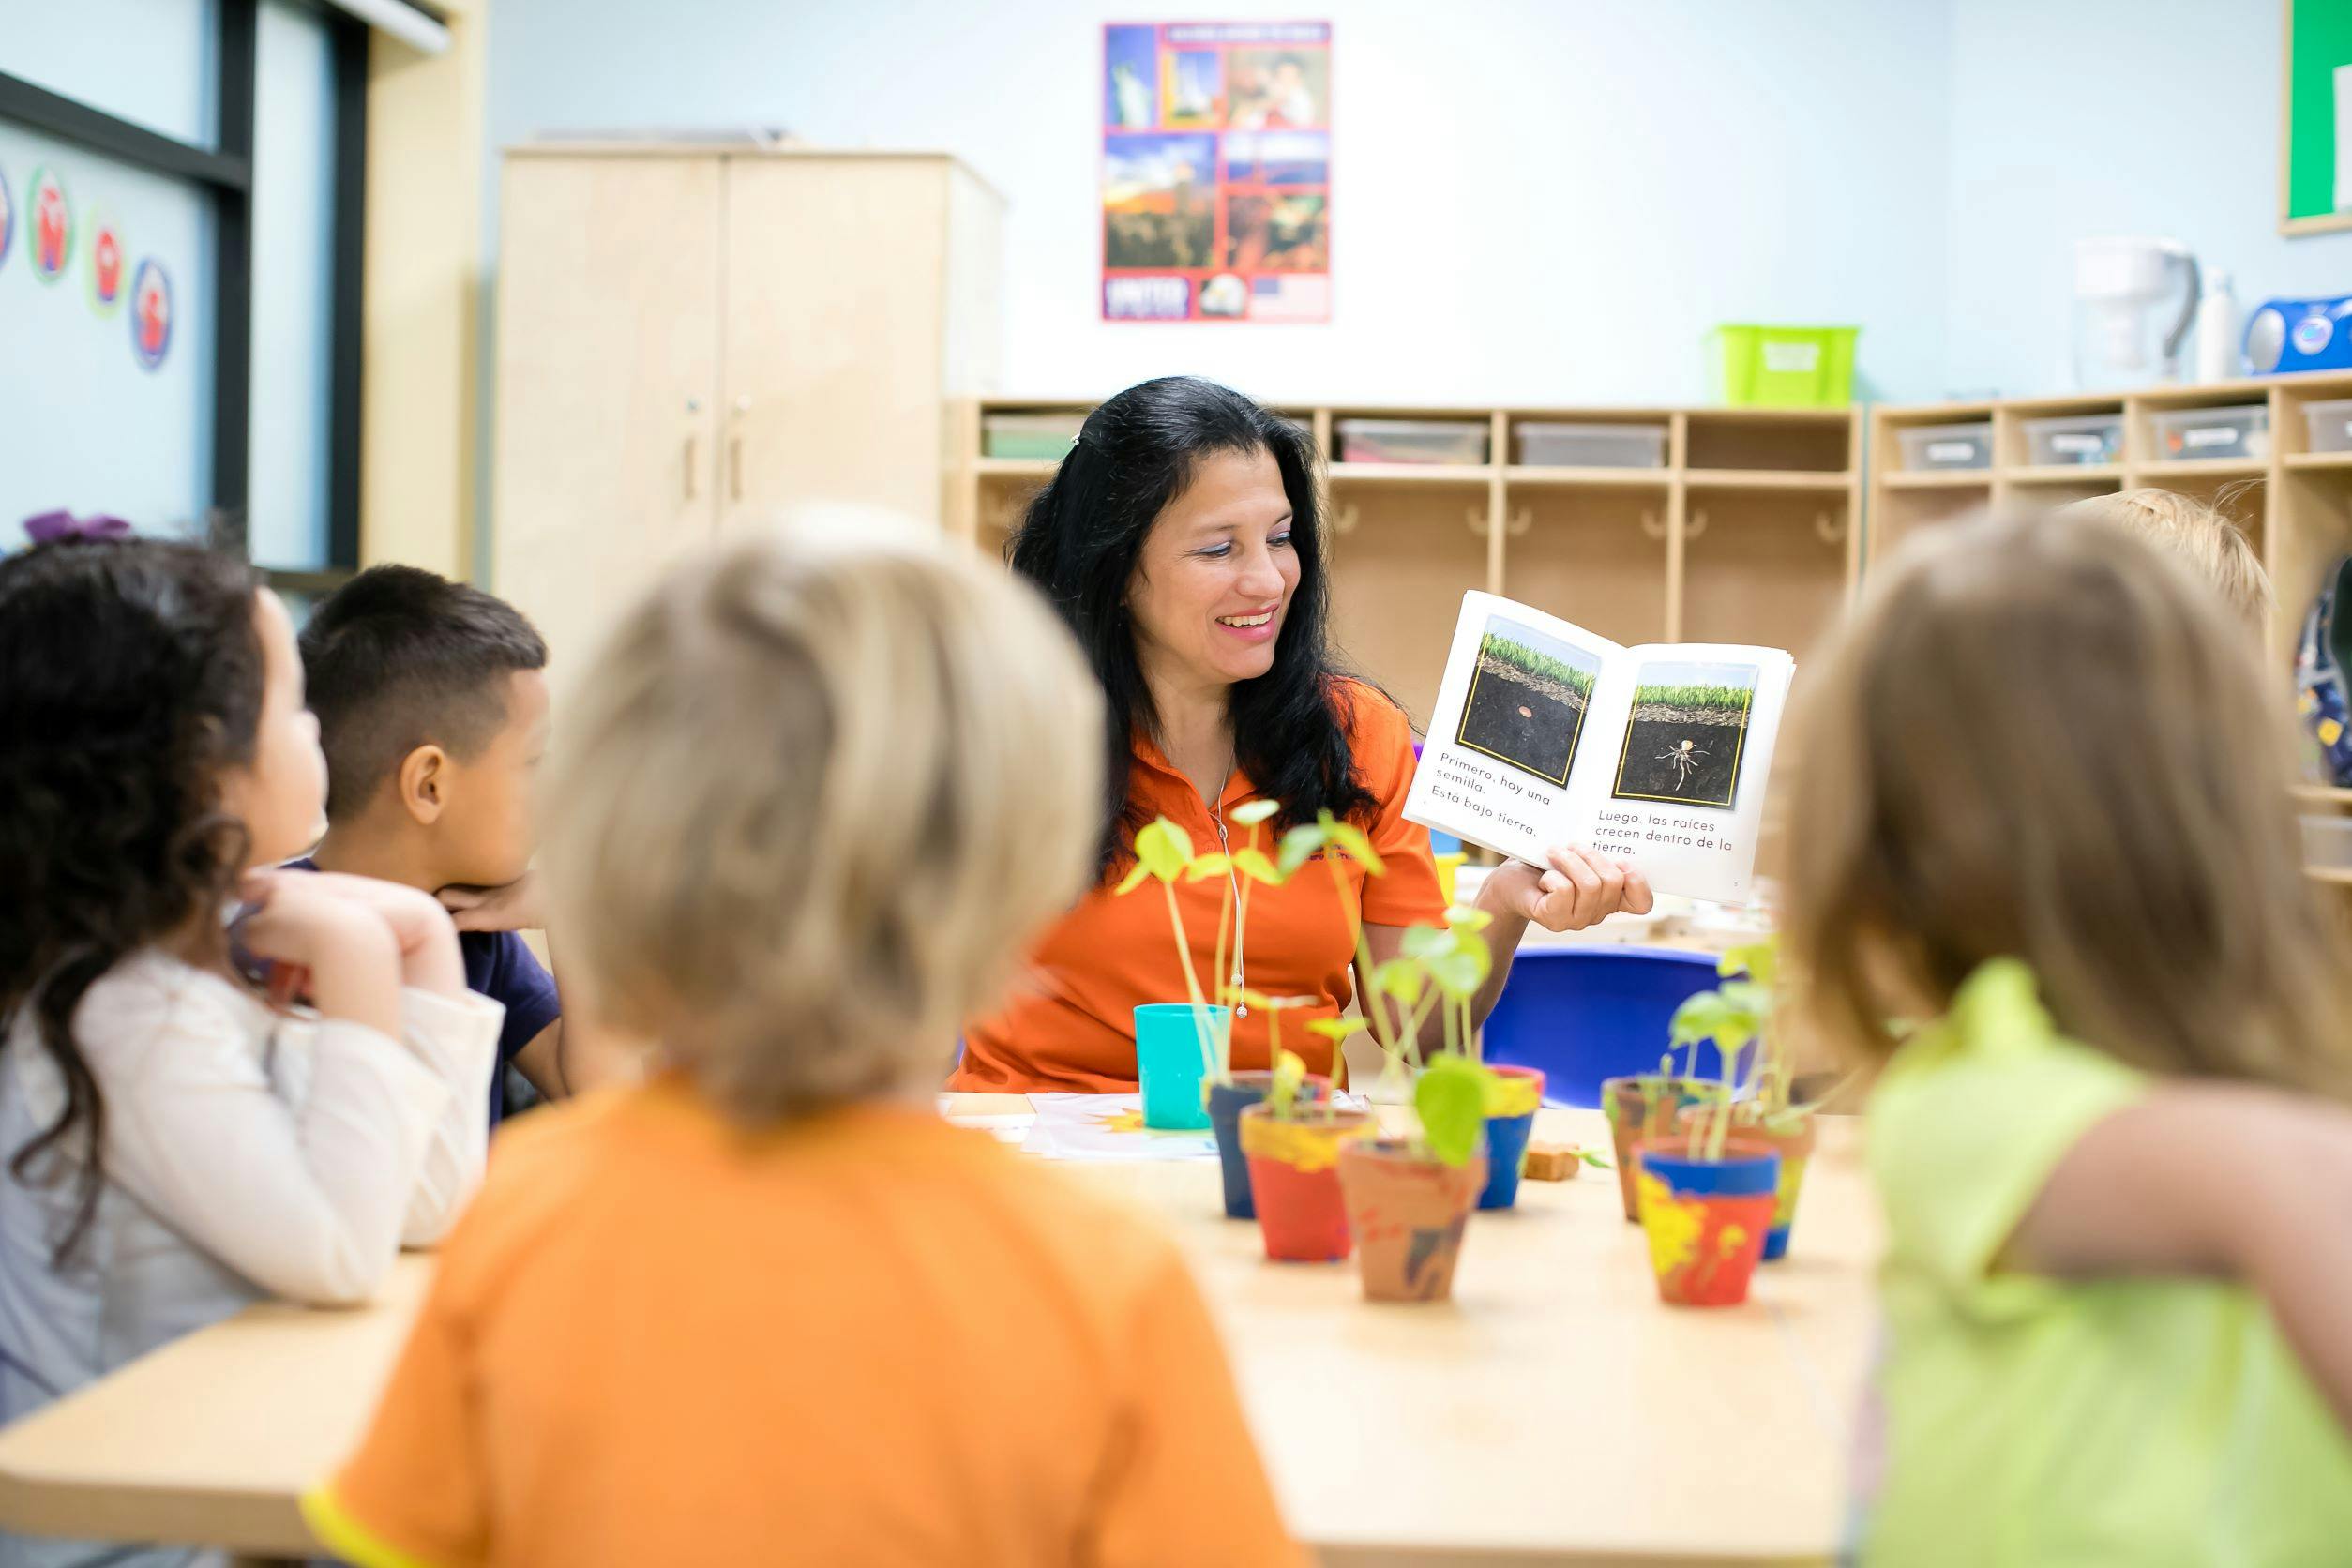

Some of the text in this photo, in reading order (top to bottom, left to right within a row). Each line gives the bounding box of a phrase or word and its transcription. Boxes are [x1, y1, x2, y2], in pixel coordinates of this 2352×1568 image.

[1437, 768, 1486, 794] semilla.
[1500, 776, 1523, 795] hay
[1528, 790, 1550, 806] una
[1431, 785, 1537, 837] Está bajo tierra.
[1648, 813, 1667, 826] las
[1672, 818, 1715, 832] raíces
[1592, 841, 1636, 855] tierra.
[1595, 826, 1732, 851] crecen dentro de la
